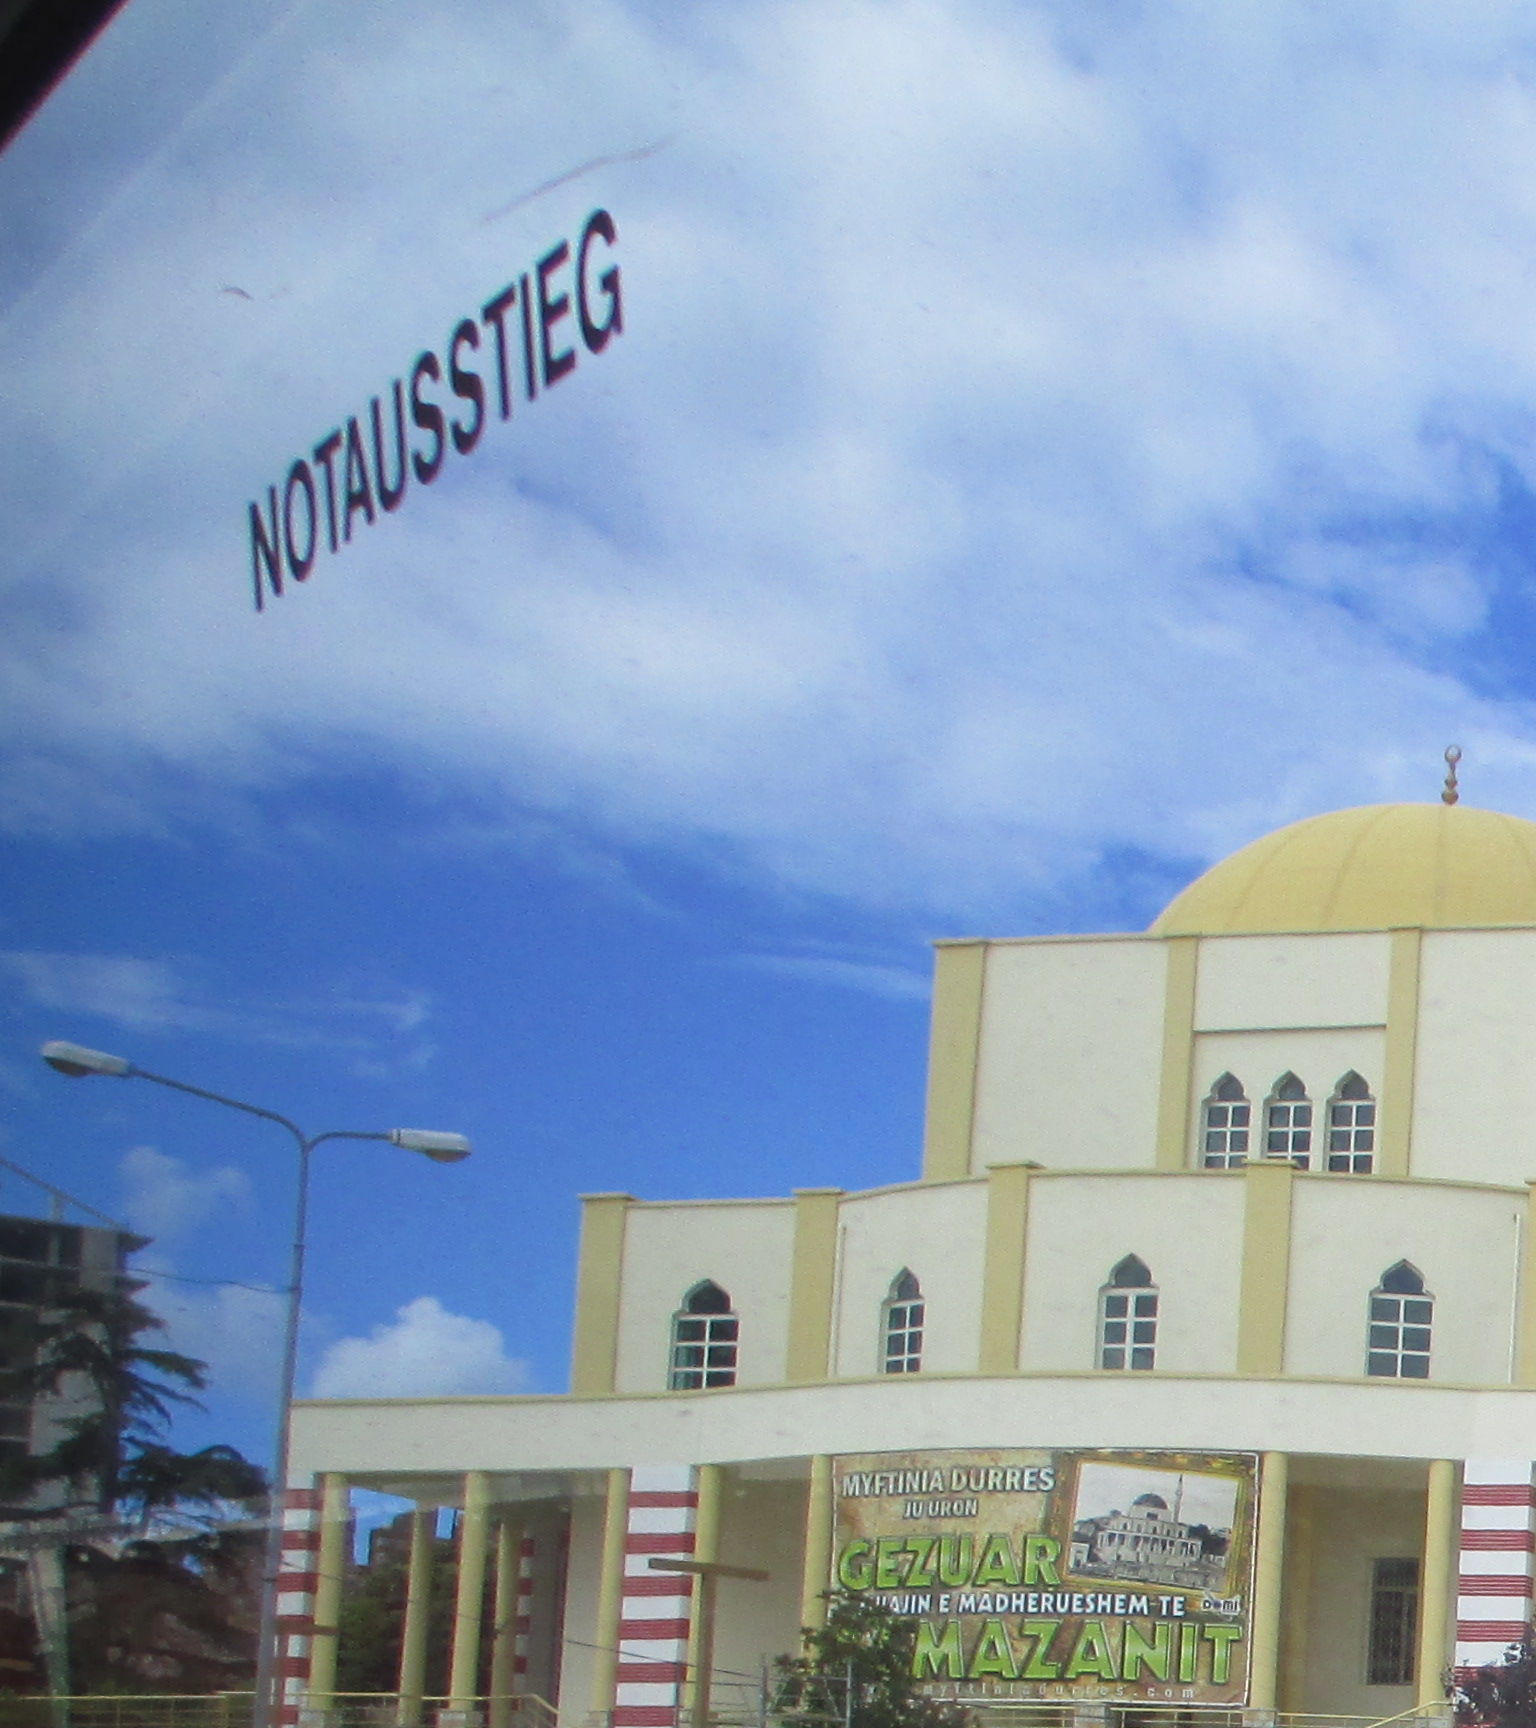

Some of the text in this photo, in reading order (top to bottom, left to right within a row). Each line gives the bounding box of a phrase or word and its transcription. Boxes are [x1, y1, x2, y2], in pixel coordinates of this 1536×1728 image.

[249, 208, 624, 613] NOTAUSSTIEG
[842, 1466, 1056, 1497] MYFTINIA DURRES
[903, 1499, 978, 1519] JU URON
[838, 1534, 1061, 1591] GEZUAR
[939, 1593, 951, 1613] E
[958, 1592, 1149, 1616] MADHERUESHEM
[1160, 1595, 1186, 1617] TE
[912, 1619, 1242, 1684] MAZANIT
